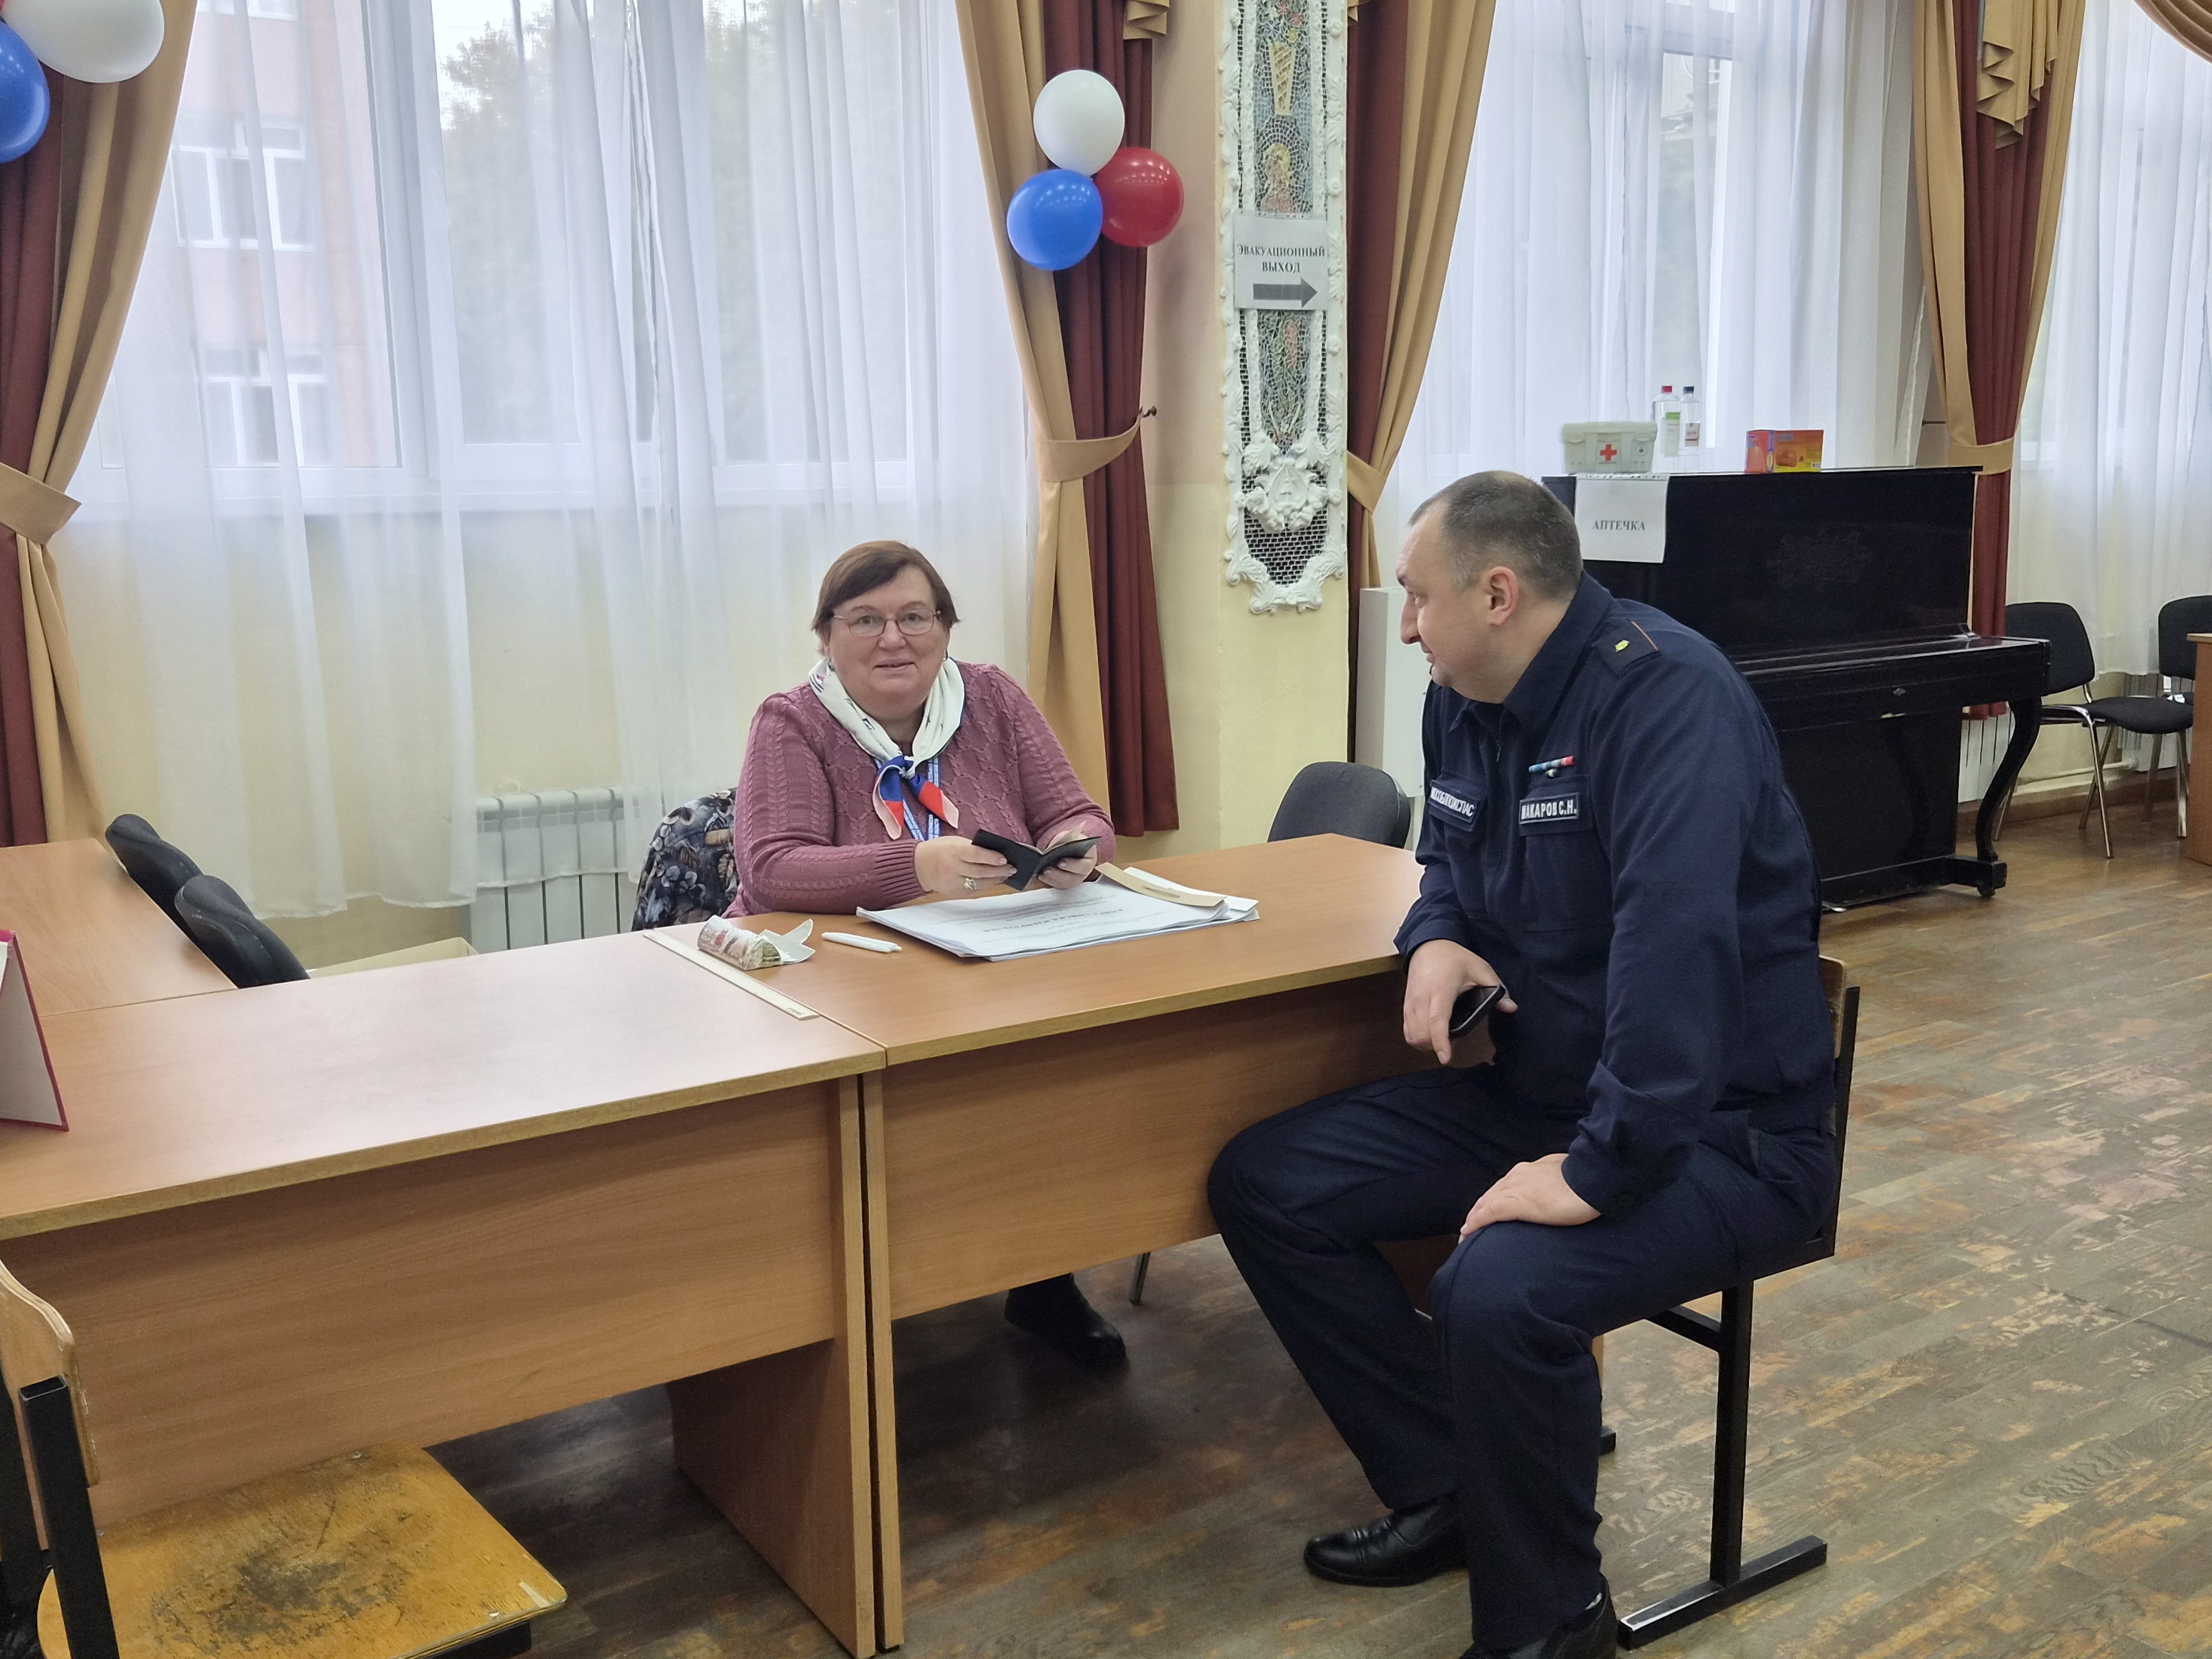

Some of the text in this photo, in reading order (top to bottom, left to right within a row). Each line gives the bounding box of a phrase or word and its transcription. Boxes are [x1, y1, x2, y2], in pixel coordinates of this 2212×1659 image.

[1237, 244, 1325, 257] ЭВАКУАЦИОННЫЙ
[1262, 262, 1301, 274] ВЫХОД
[1593, 520, 1645, 531] АПТЕЧКА
[1521, 799, 1578, 820] МАКАРОВ С.Н.
